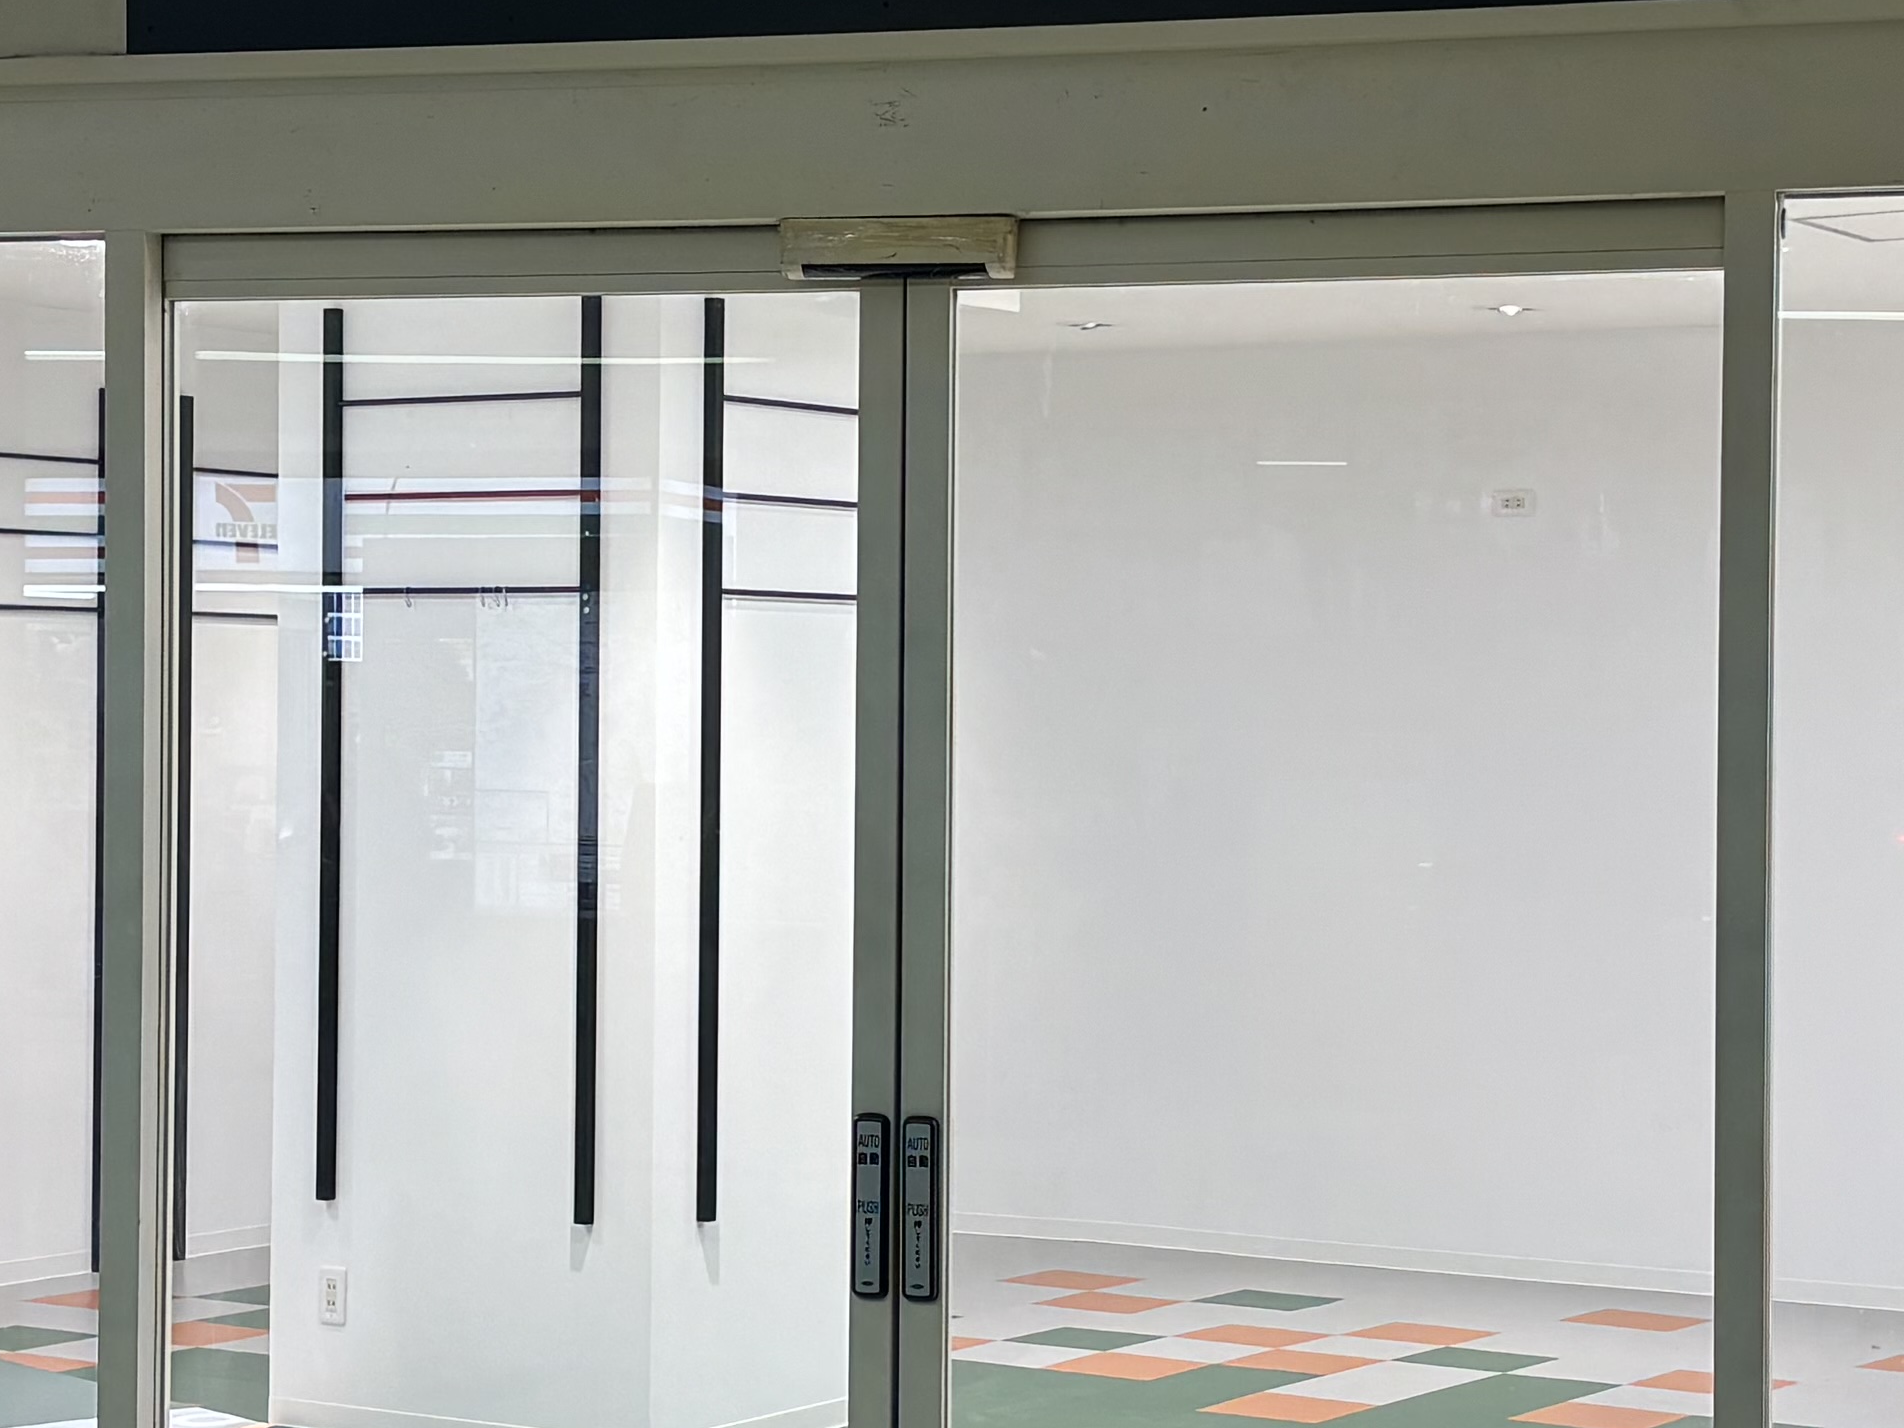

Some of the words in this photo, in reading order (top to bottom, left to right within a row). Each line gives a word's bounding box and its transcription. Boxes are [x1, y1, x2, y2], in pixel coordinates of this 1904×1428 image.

[858, 1134, 880, 1148] AUTO
[907, 1137, 929, 1151] AUTO
[857, 1199, 879, 1214] PUSH
[907, 1203, 929, 1217] PUSH
